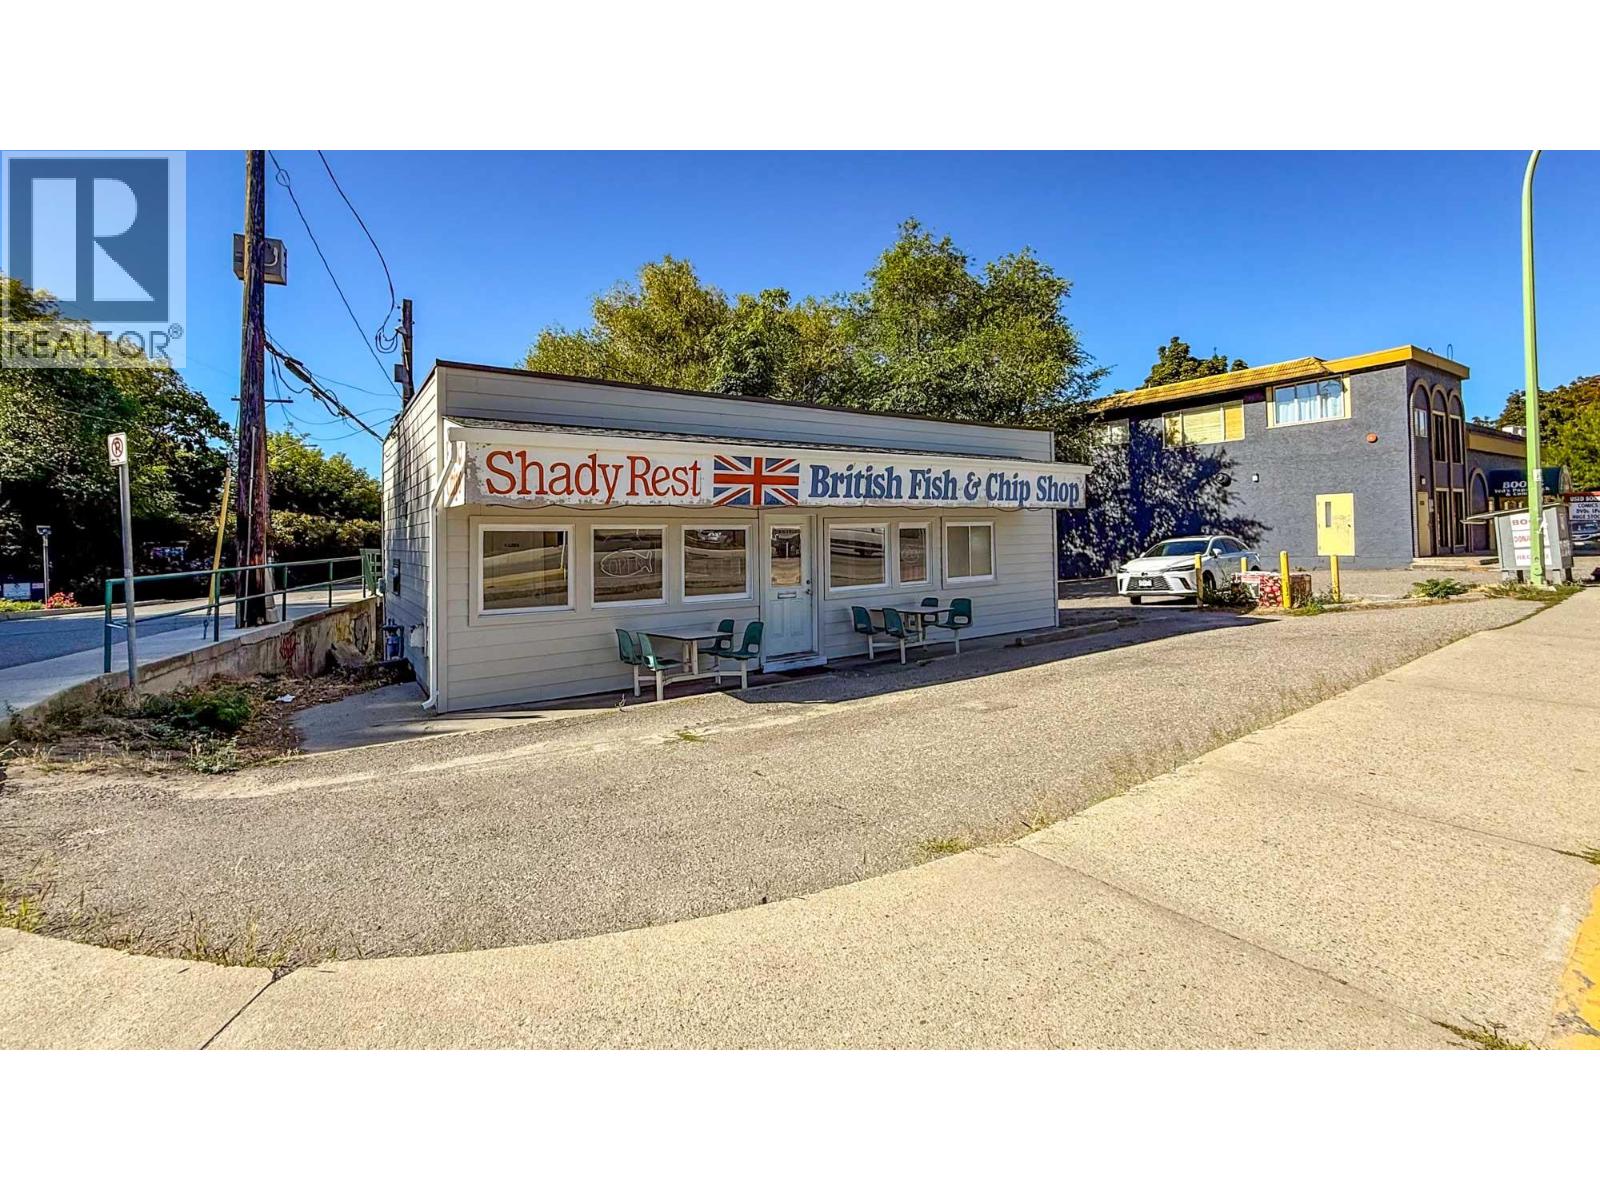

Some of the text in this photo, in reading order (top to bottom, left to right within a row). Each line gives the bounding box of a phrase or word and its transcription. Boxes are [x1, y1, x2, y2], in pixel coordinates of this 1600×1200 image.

[486, 450, 701, 504] Shady Rest
[808, 464, 1079, 507] British Fish & Chip Shop
